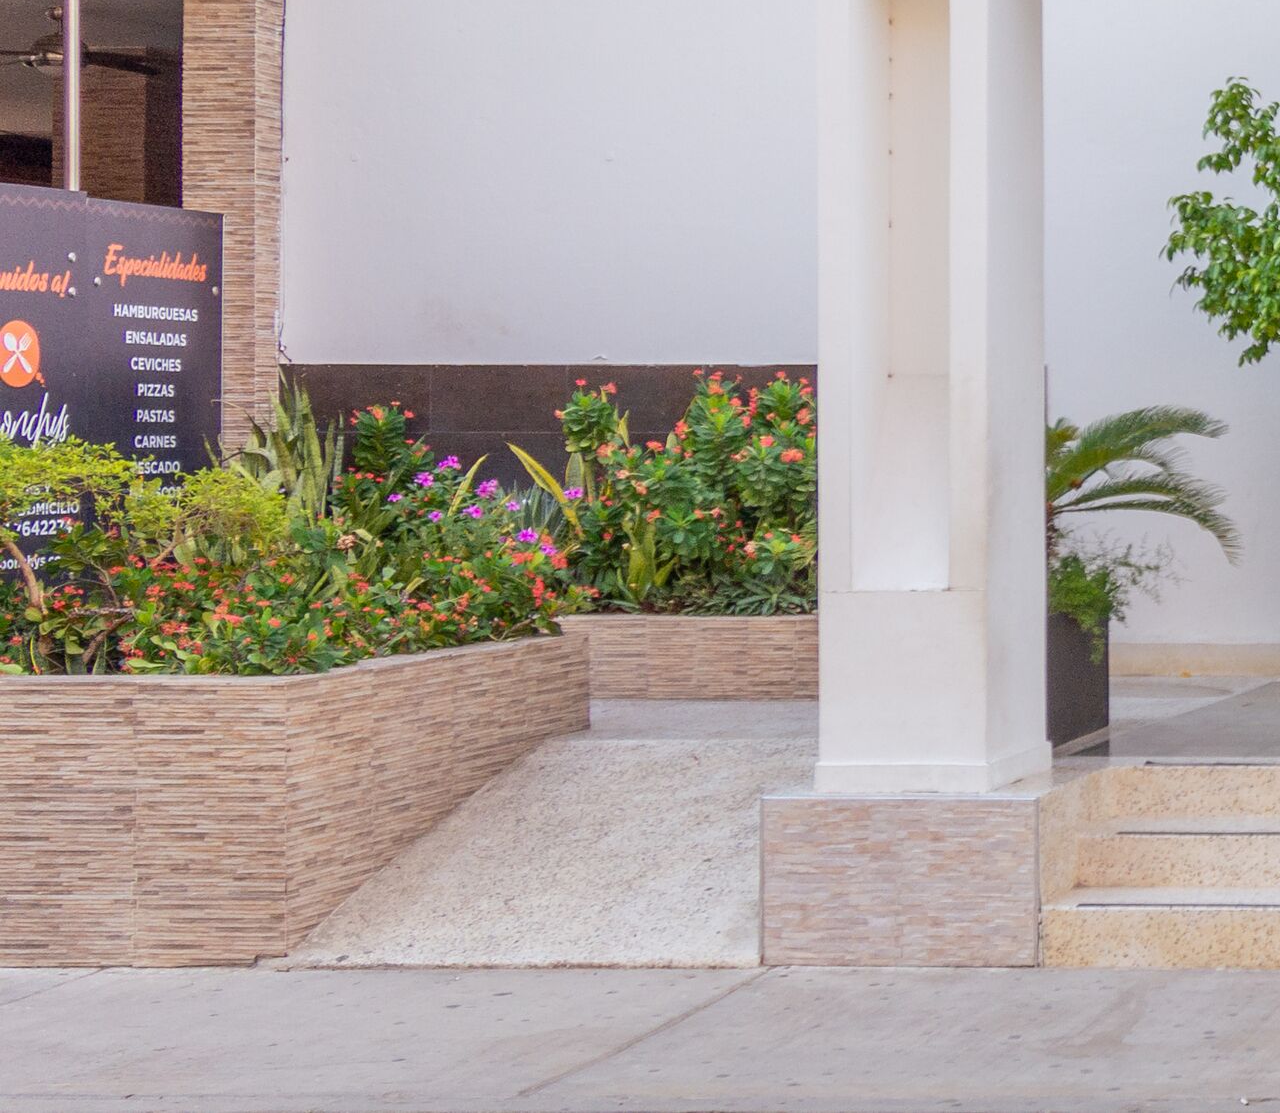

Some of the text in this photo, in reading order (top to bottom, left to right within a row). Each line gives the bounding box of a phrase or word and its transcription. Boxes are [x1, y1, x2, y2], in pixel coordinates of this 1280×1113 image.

[104, 243, 208, 287] Especialidades
[113, 303, 199, 322] HAMBURGUESAS
[125, 330, 187, 347] ENSALADAS
[130, 356, 182, 372] CEVICHES
[137, 383, 175, 397] PIZZAS
[136, 409, 175, 423] PASTAS
[134, 435, 177, 448] CARNES
[133, 460, 181, 475] ESCADO
